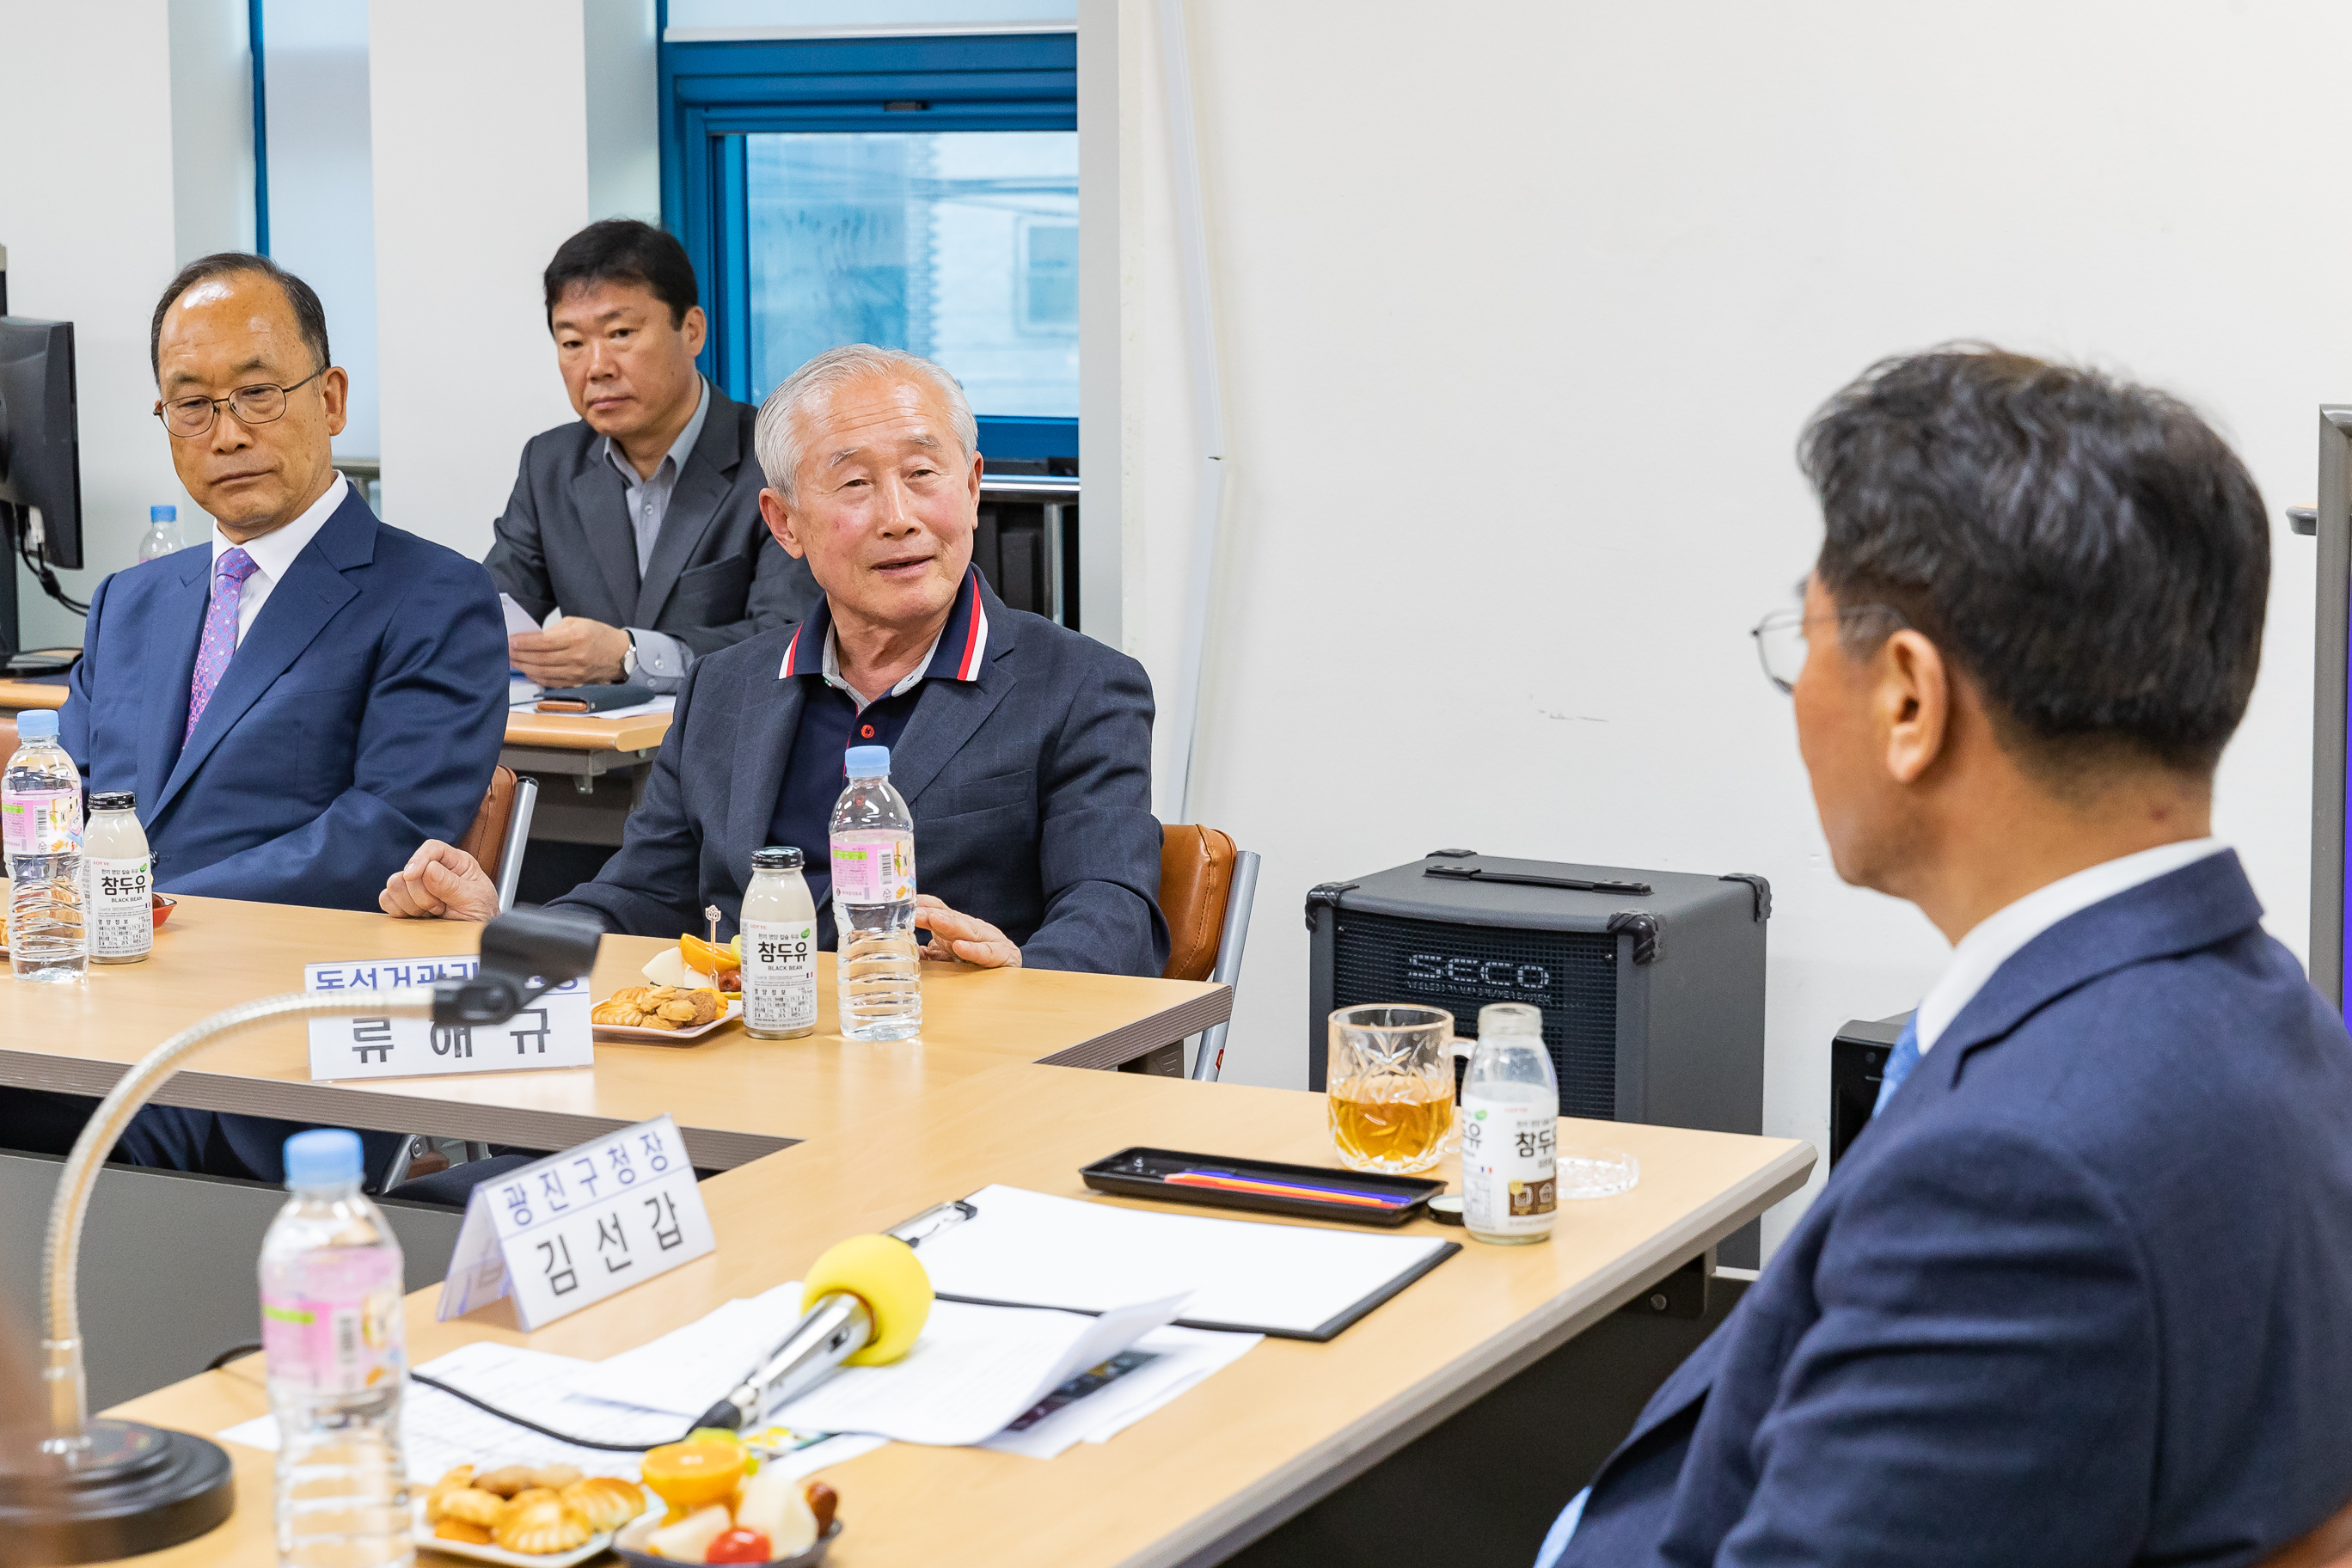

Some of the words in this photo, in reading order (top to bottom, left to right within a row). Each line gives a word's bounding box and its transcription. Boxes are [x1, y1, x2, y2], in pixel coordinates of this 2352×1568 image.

[101, 874, 146, 896] 참두유
[757, 940, 808, 963] 참두유
[1407, 953, 1550, 989] SECO
[502, 1130, 669, 1227] 광진구청장
